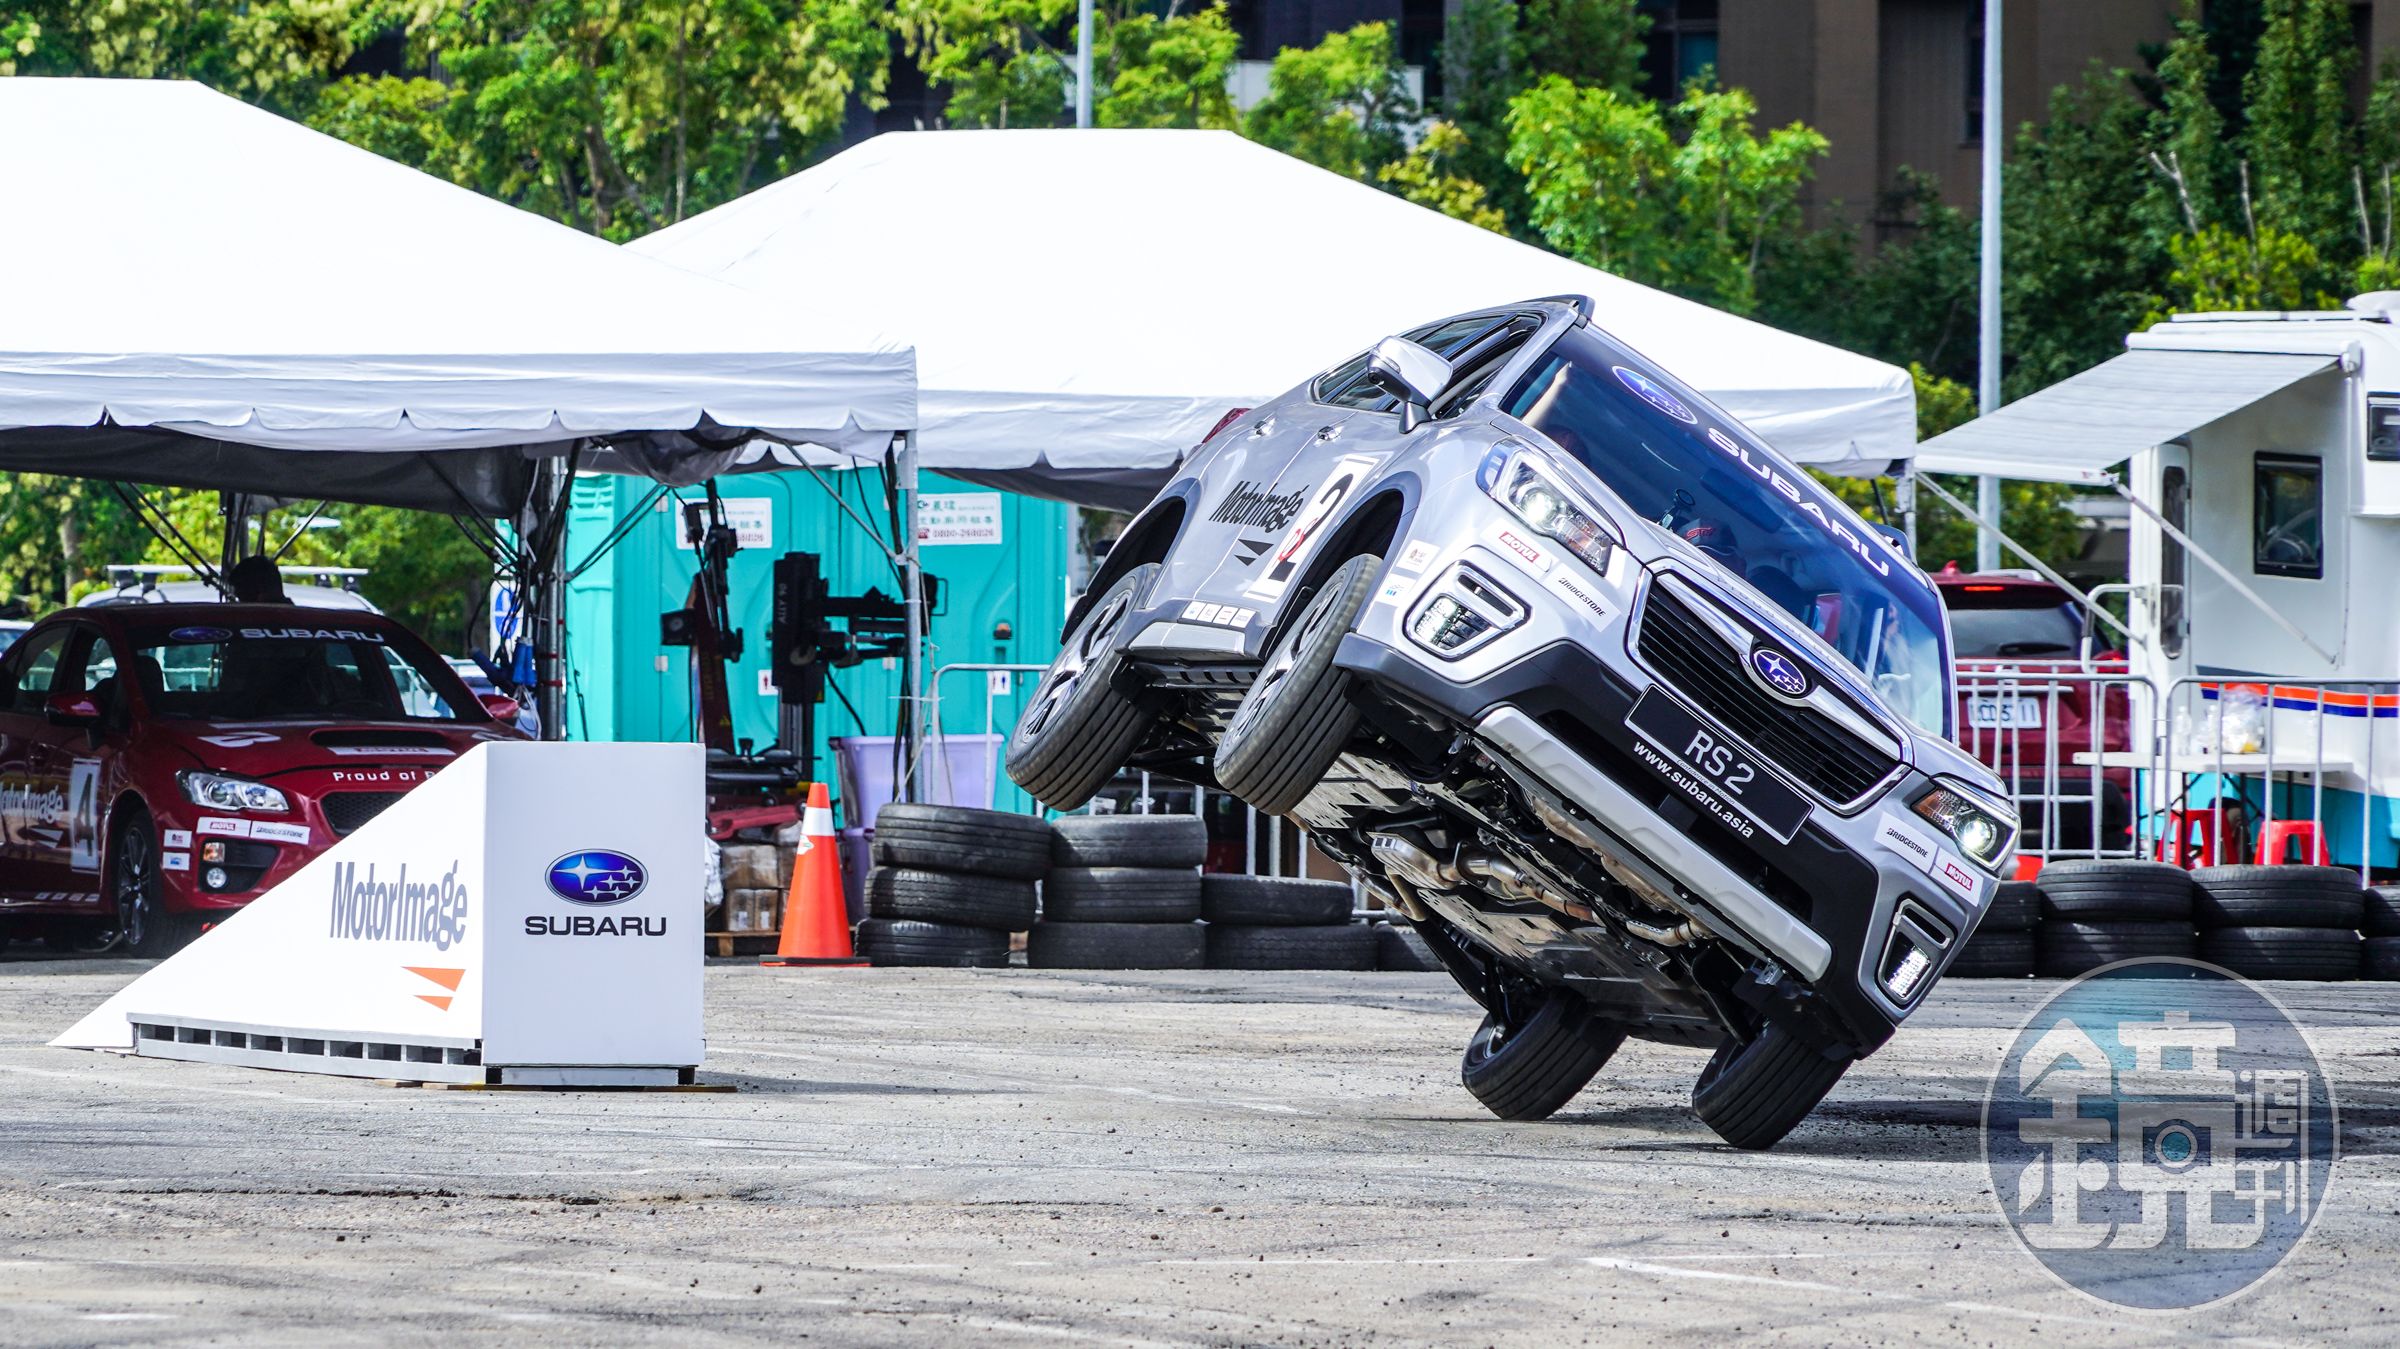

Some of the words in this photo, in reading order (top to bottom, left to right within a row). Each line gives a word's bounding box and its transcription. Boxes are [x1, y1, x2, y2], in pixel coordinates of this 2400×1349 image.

[1209, 480, 1310, 533] MotorImage
[1708, 427, 1890, 577] SUBARU
[1500, 532, 1540, 563] MOTUL
[1558, 577, 1606, 617] BRIDGESTONE
[239, 628, 385, 643] SUBARU
[332, 771, 391, 783] Proud
[399, 771, 417, 782] of
[1633, 741, 1754, 838] www.subaru.asia
[74, 772, 94, 857] 4
[1886, 827, 1929, 858] BRIDGESTONE
[1945, 863, 1973, 891] MOTUL
[330, 859, 468, 952] MotorImage
[524, 915, 667, 937] SUBARU
